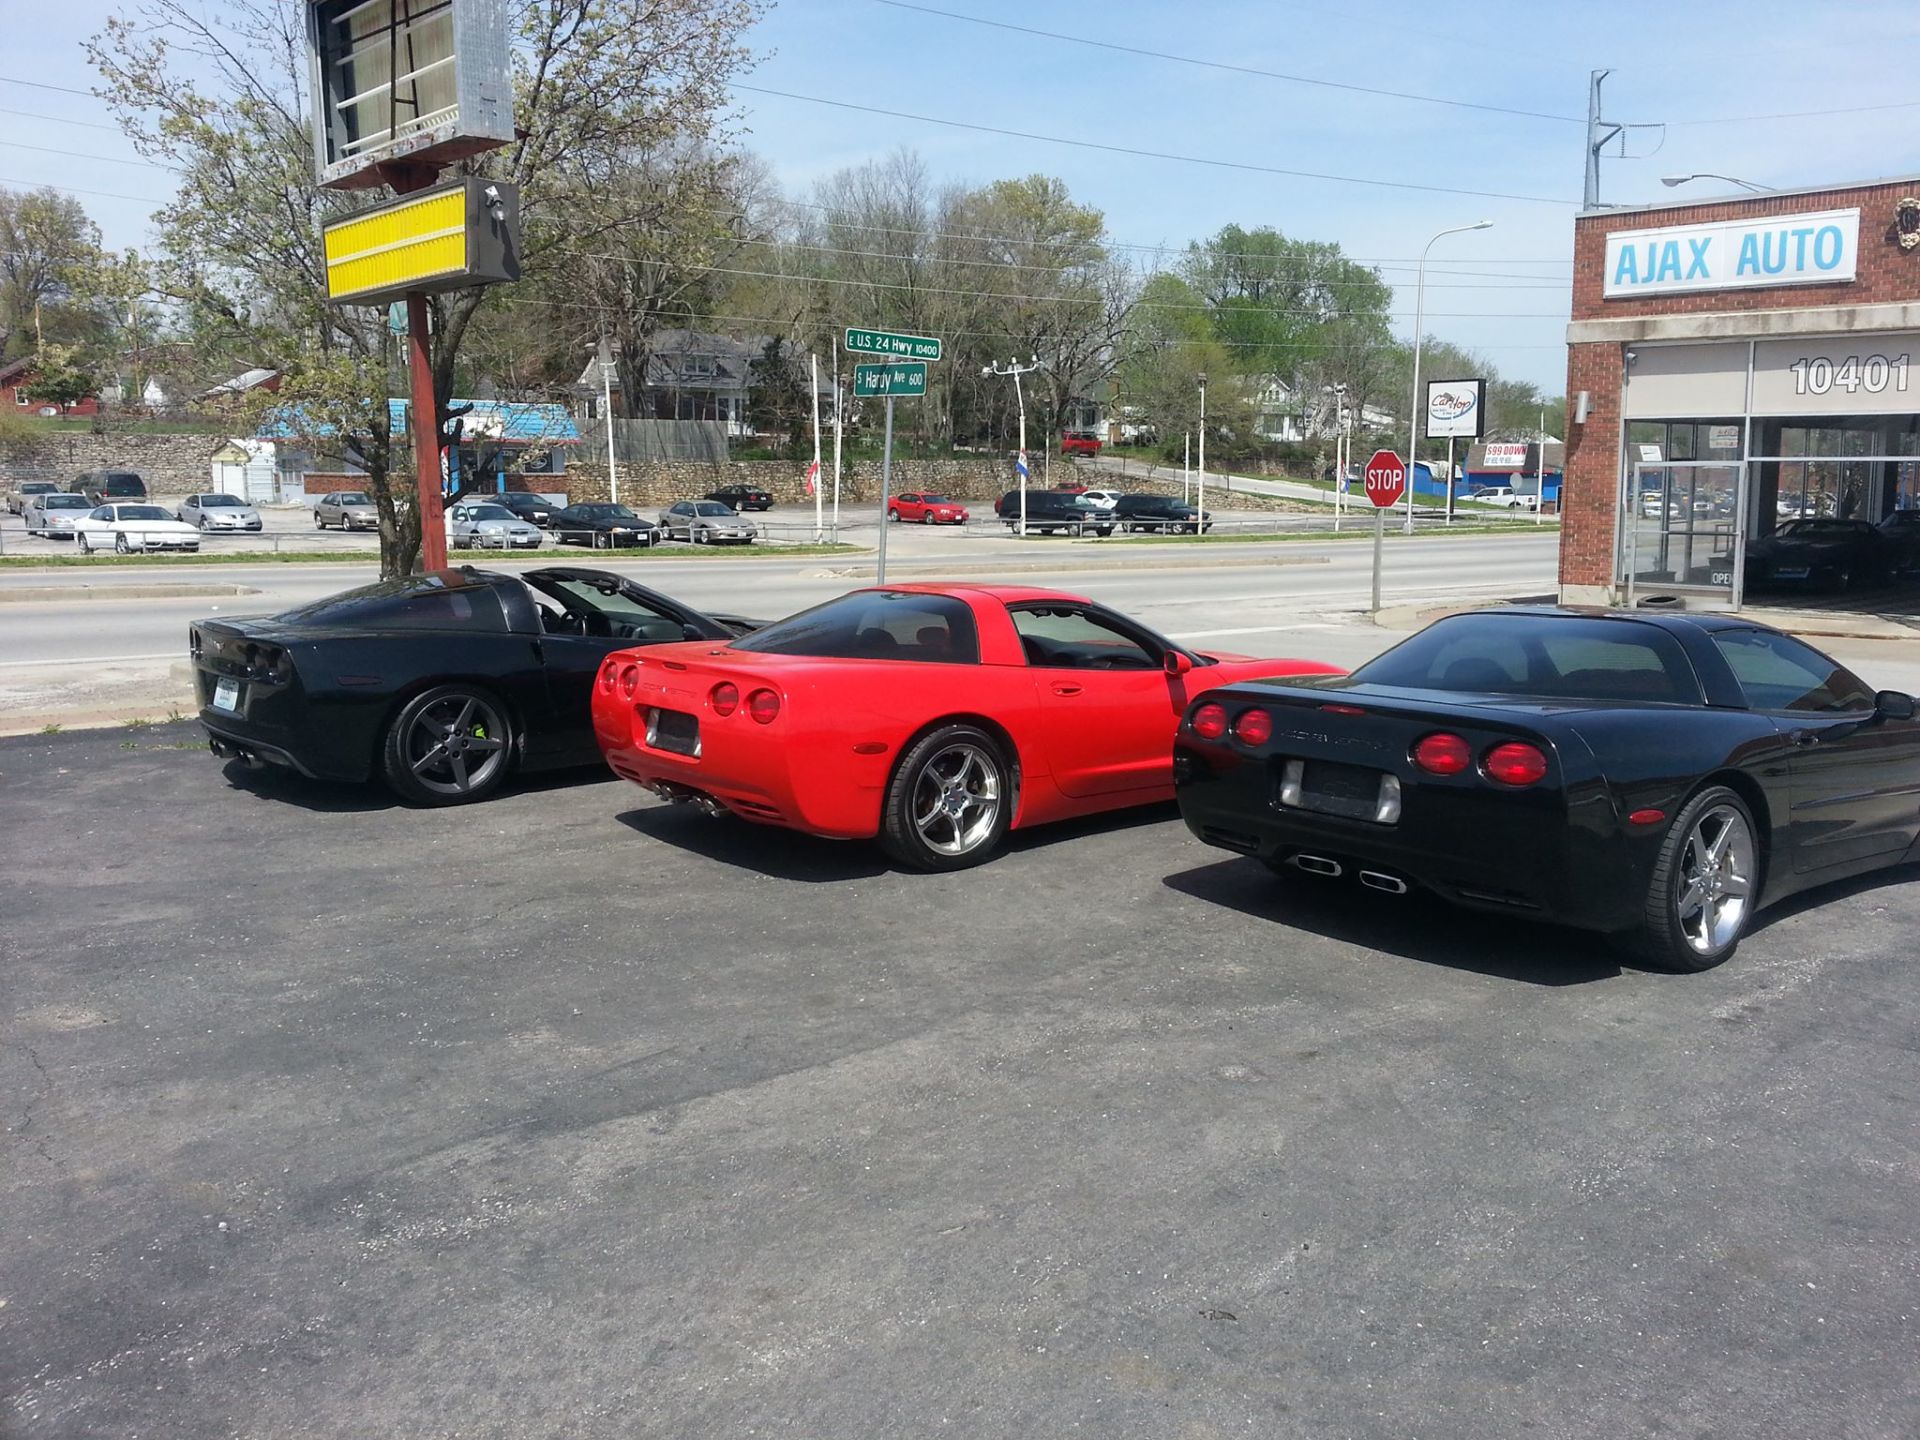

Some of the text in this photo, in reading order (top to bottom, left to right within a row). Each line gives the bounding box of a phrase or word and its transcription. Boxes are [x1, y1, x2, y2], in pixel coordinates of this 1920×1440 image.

[1614, 225, 1843, 286] AJAX AUTO
[849, 334, 937, 356] E U.S. 24 Hwy 10400
[857, 370, 922, 394] S Hardy Ave 600
[1790, 353, 1910, 396] 10401
[1503, 445, 1528, 456] DOWN
[1367, 468, 1403, 491] STOP
